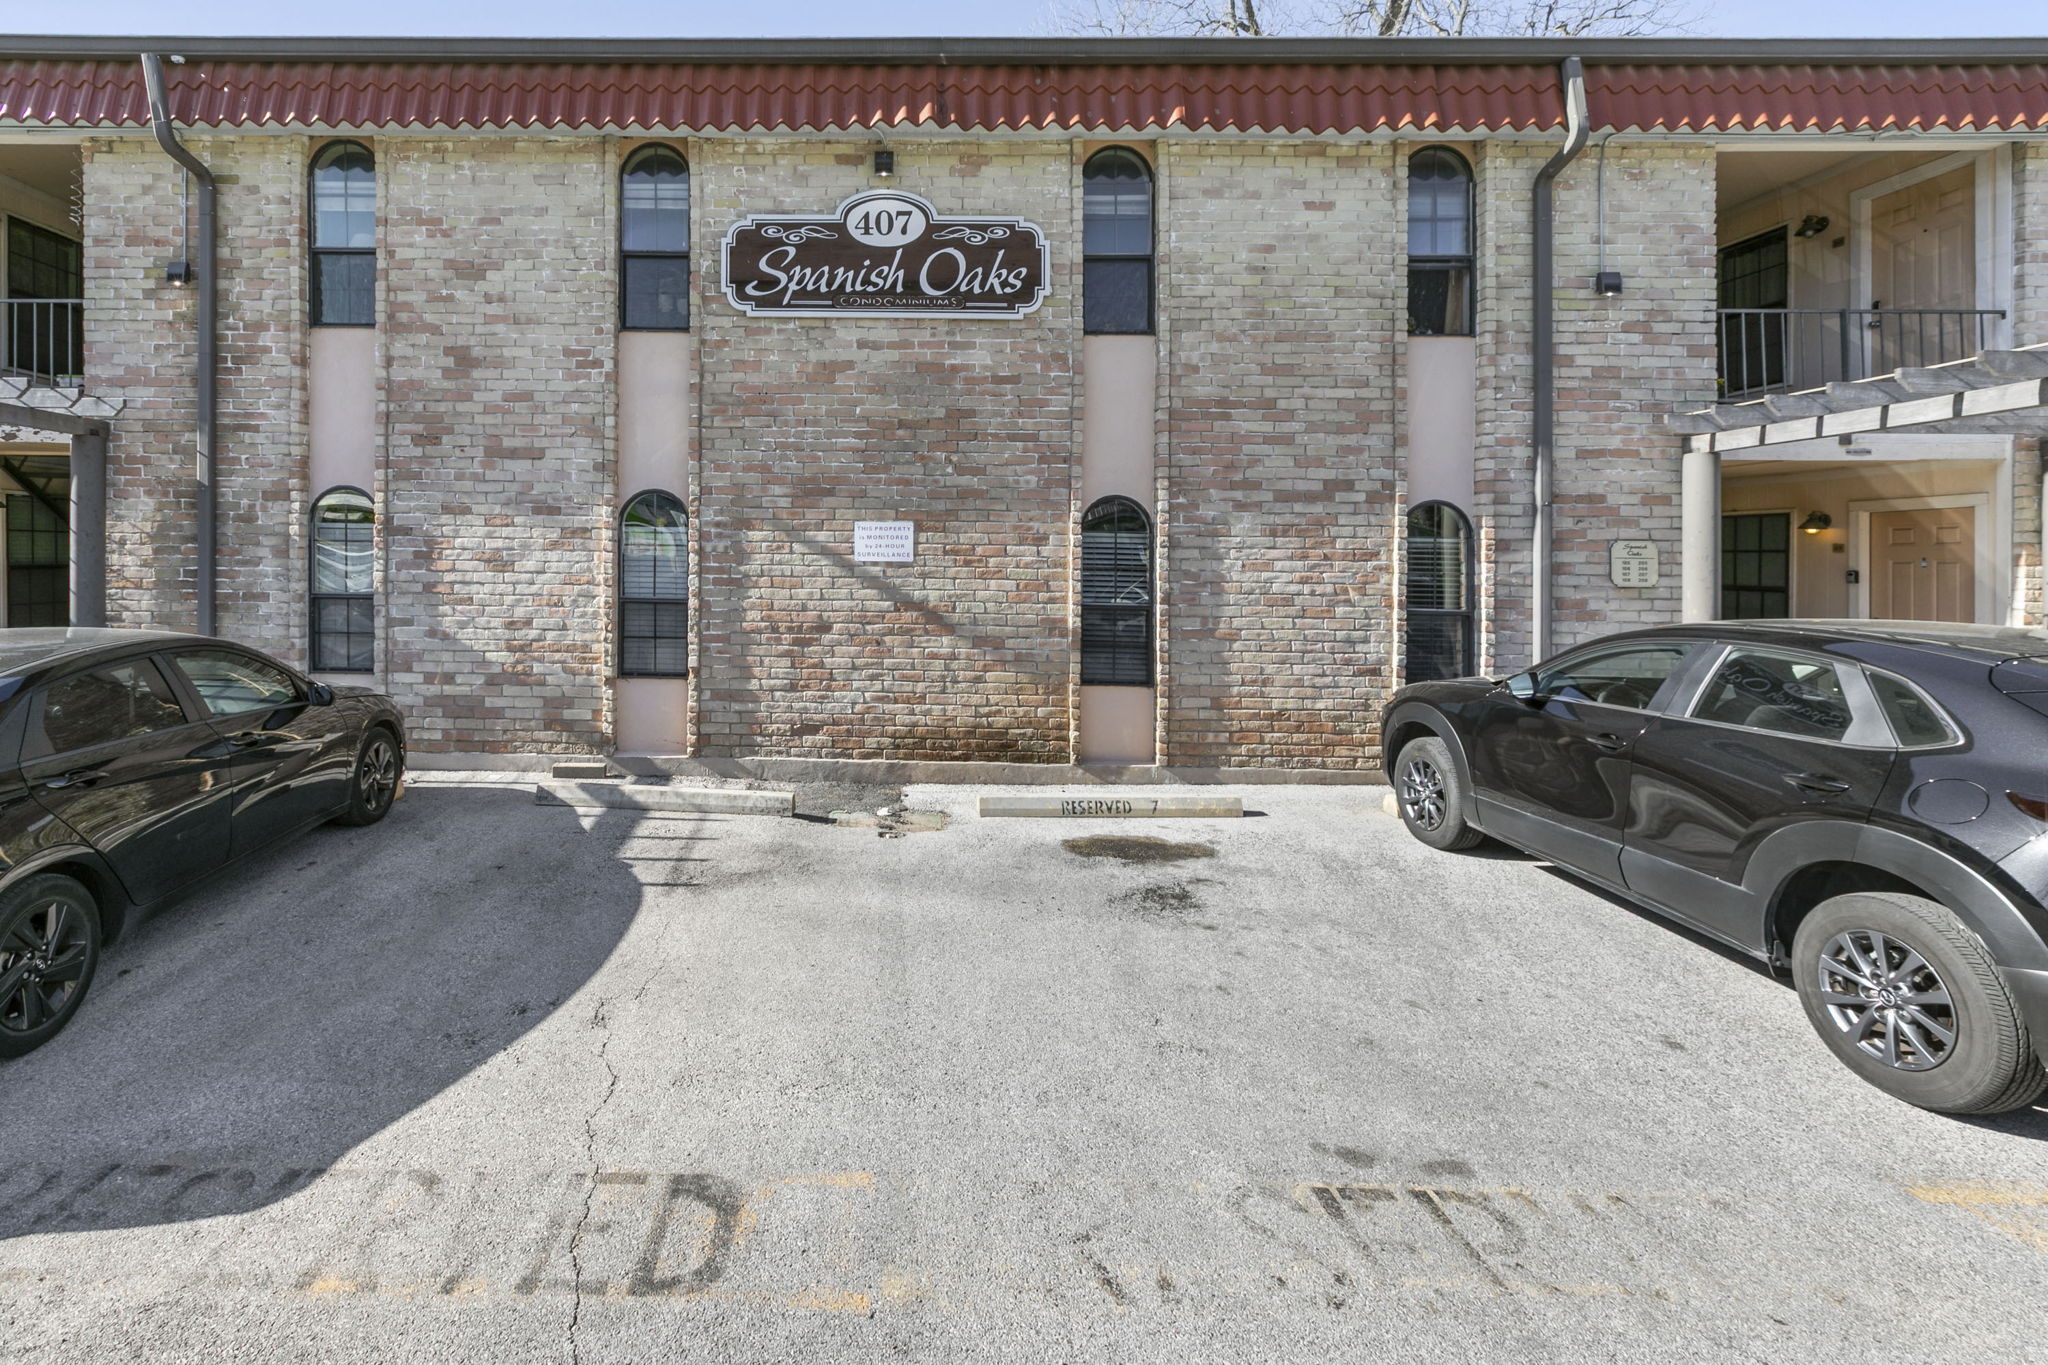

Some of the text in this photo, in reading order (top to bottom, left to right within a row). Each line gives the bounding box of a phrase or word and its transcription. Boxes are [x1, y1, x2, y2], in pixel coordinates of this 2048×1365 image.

[854, 209, 914, 236] 407
[744, 246, 1028, 306] Spanish Oaks
[839, 297, 958, 308] CONDOMINIUMS
[1061, 800, 1160, 816] RESERVED 7
